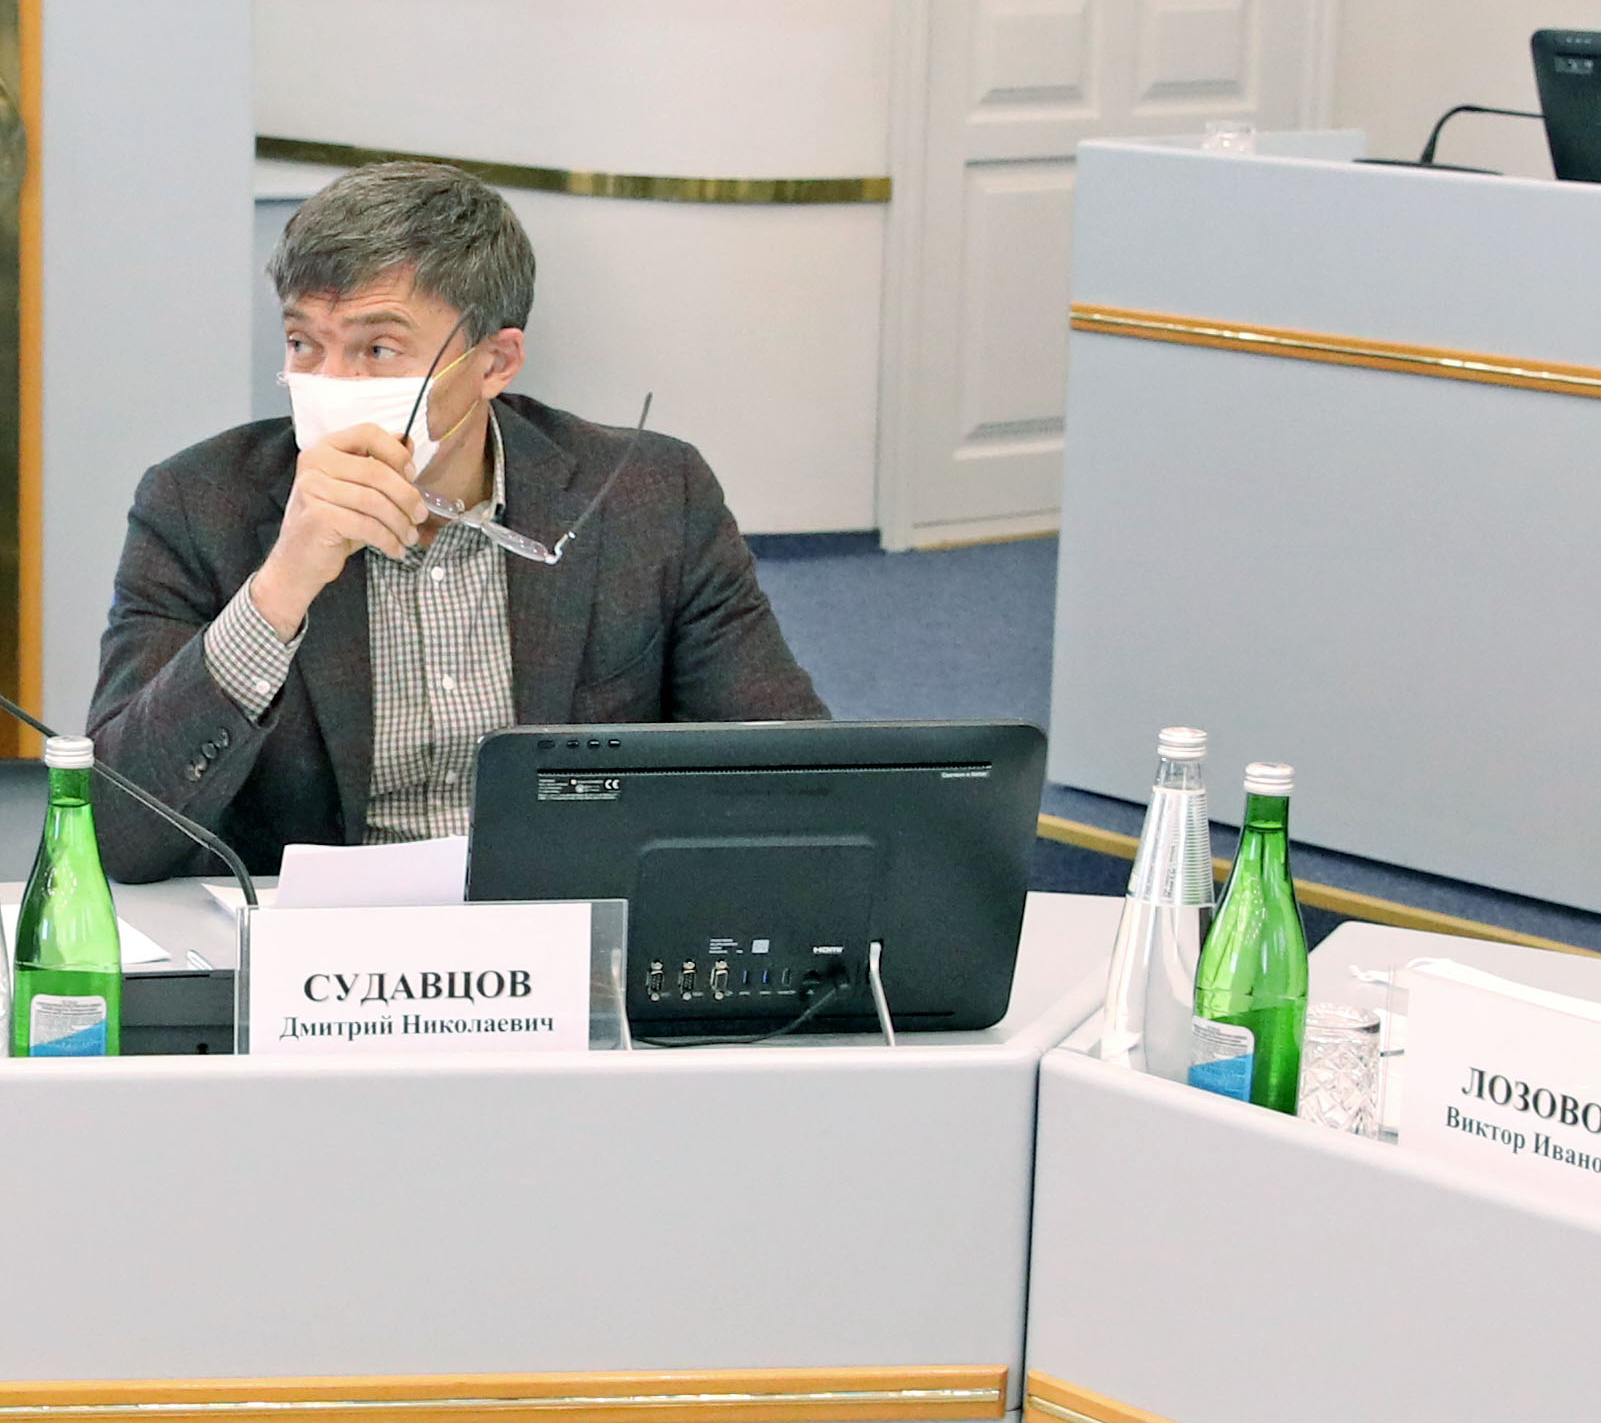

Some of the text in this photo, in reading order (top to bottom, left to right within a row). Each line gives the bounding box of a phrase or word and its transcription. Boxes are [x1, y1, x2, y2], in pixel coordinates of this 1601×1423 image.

[303, 969, 533, 1007] СУДАВЦОВ
[279, 1014, 554, 1041] Дмитрий Николаевич
[1445, 1106, 1526, 1154] Виктор
